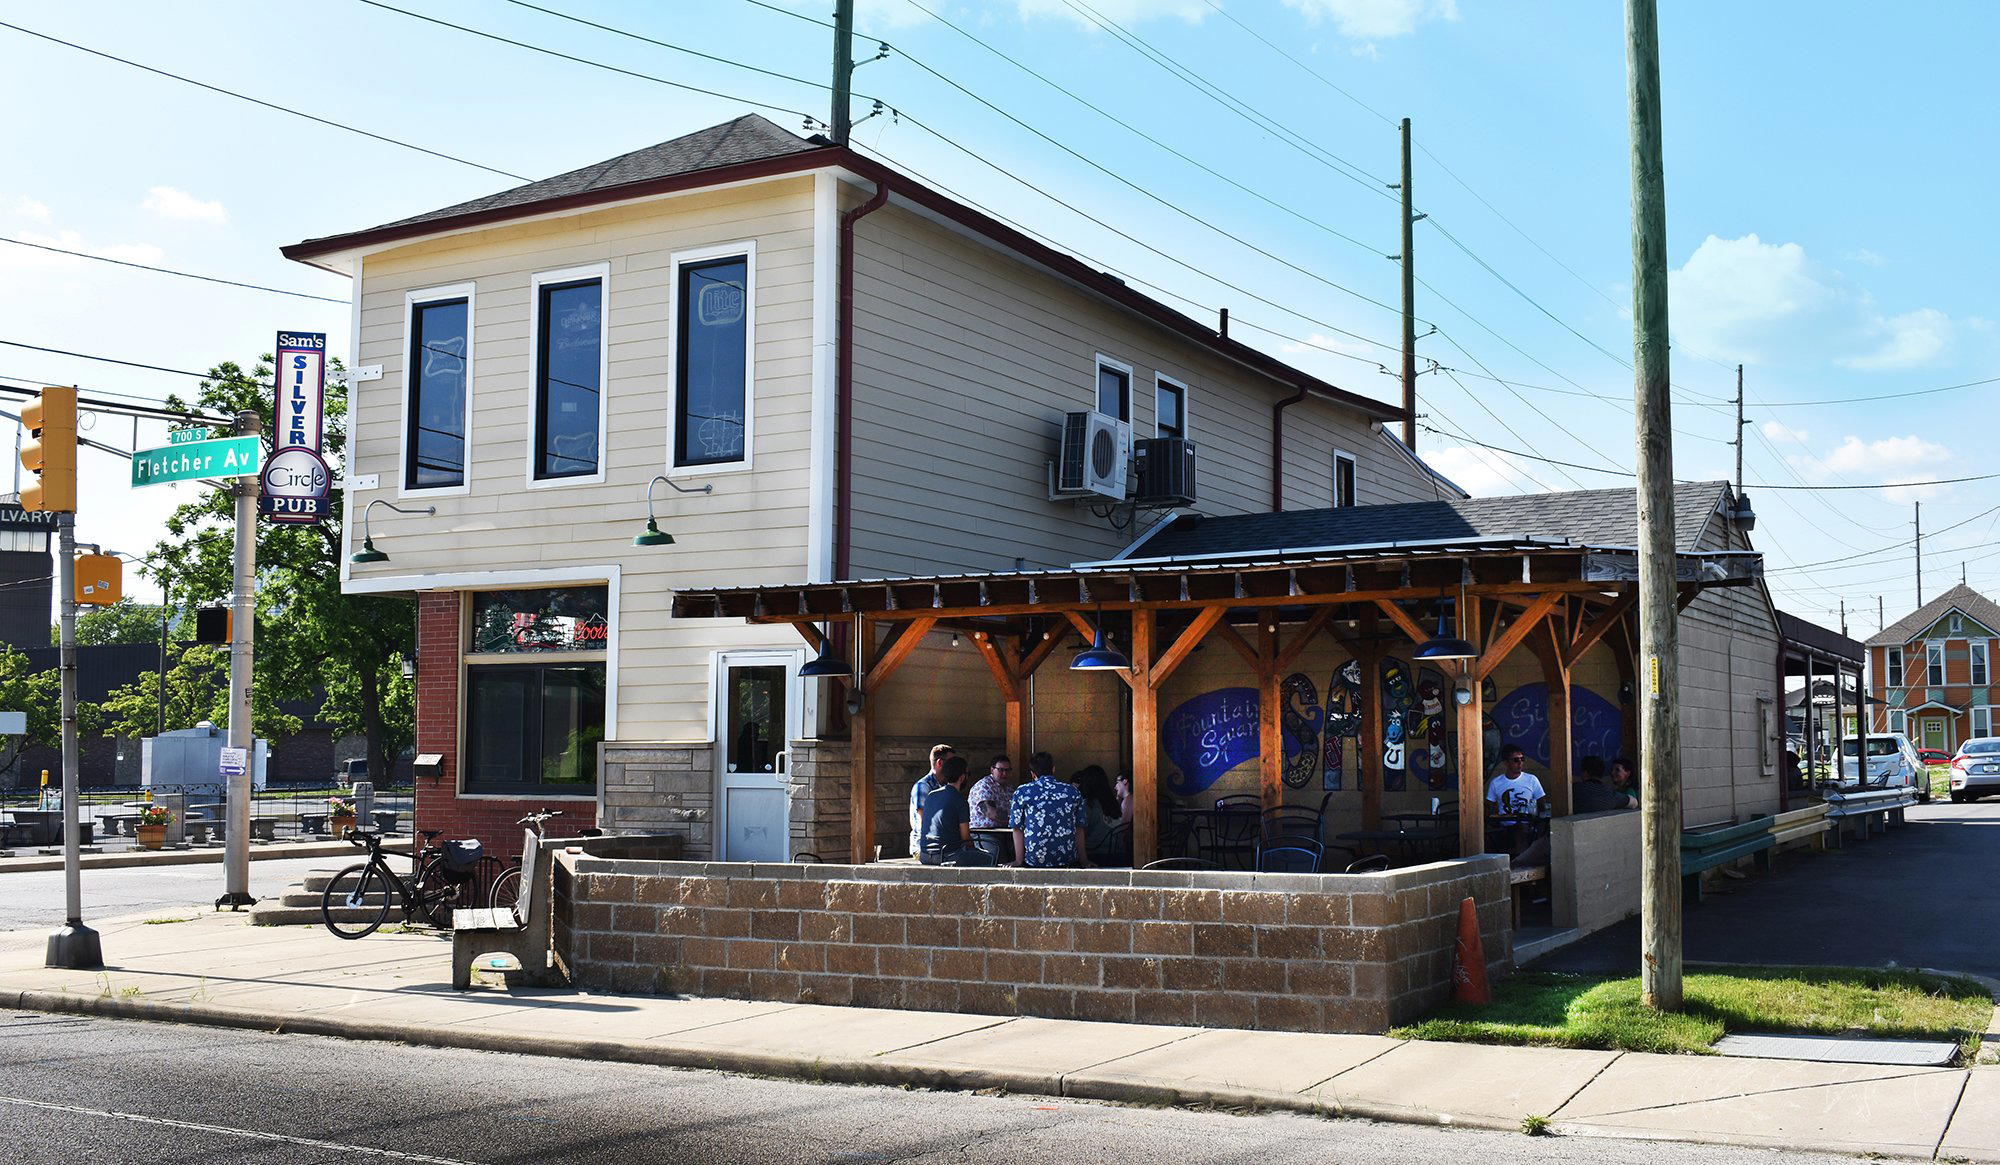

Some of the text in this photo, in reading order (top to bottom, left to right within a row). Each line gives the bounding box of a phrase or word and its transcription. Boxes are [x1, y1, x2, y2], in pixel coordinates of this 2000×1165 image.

[279, 333, 324, 348] Sam's
[289, 355, 308, 445] SILVER
[175, 430, 202, 442] 700 S
[138, 448, 250, 478] Fletcher Av
[267, 466, 326, 492] Circle
[0, 510, 54, 523] LVARY
[272, 498, 317, 513] PUB
[1509, 697, 1602, 738] Sier
[1200, 721, 1260, 767] Squar
